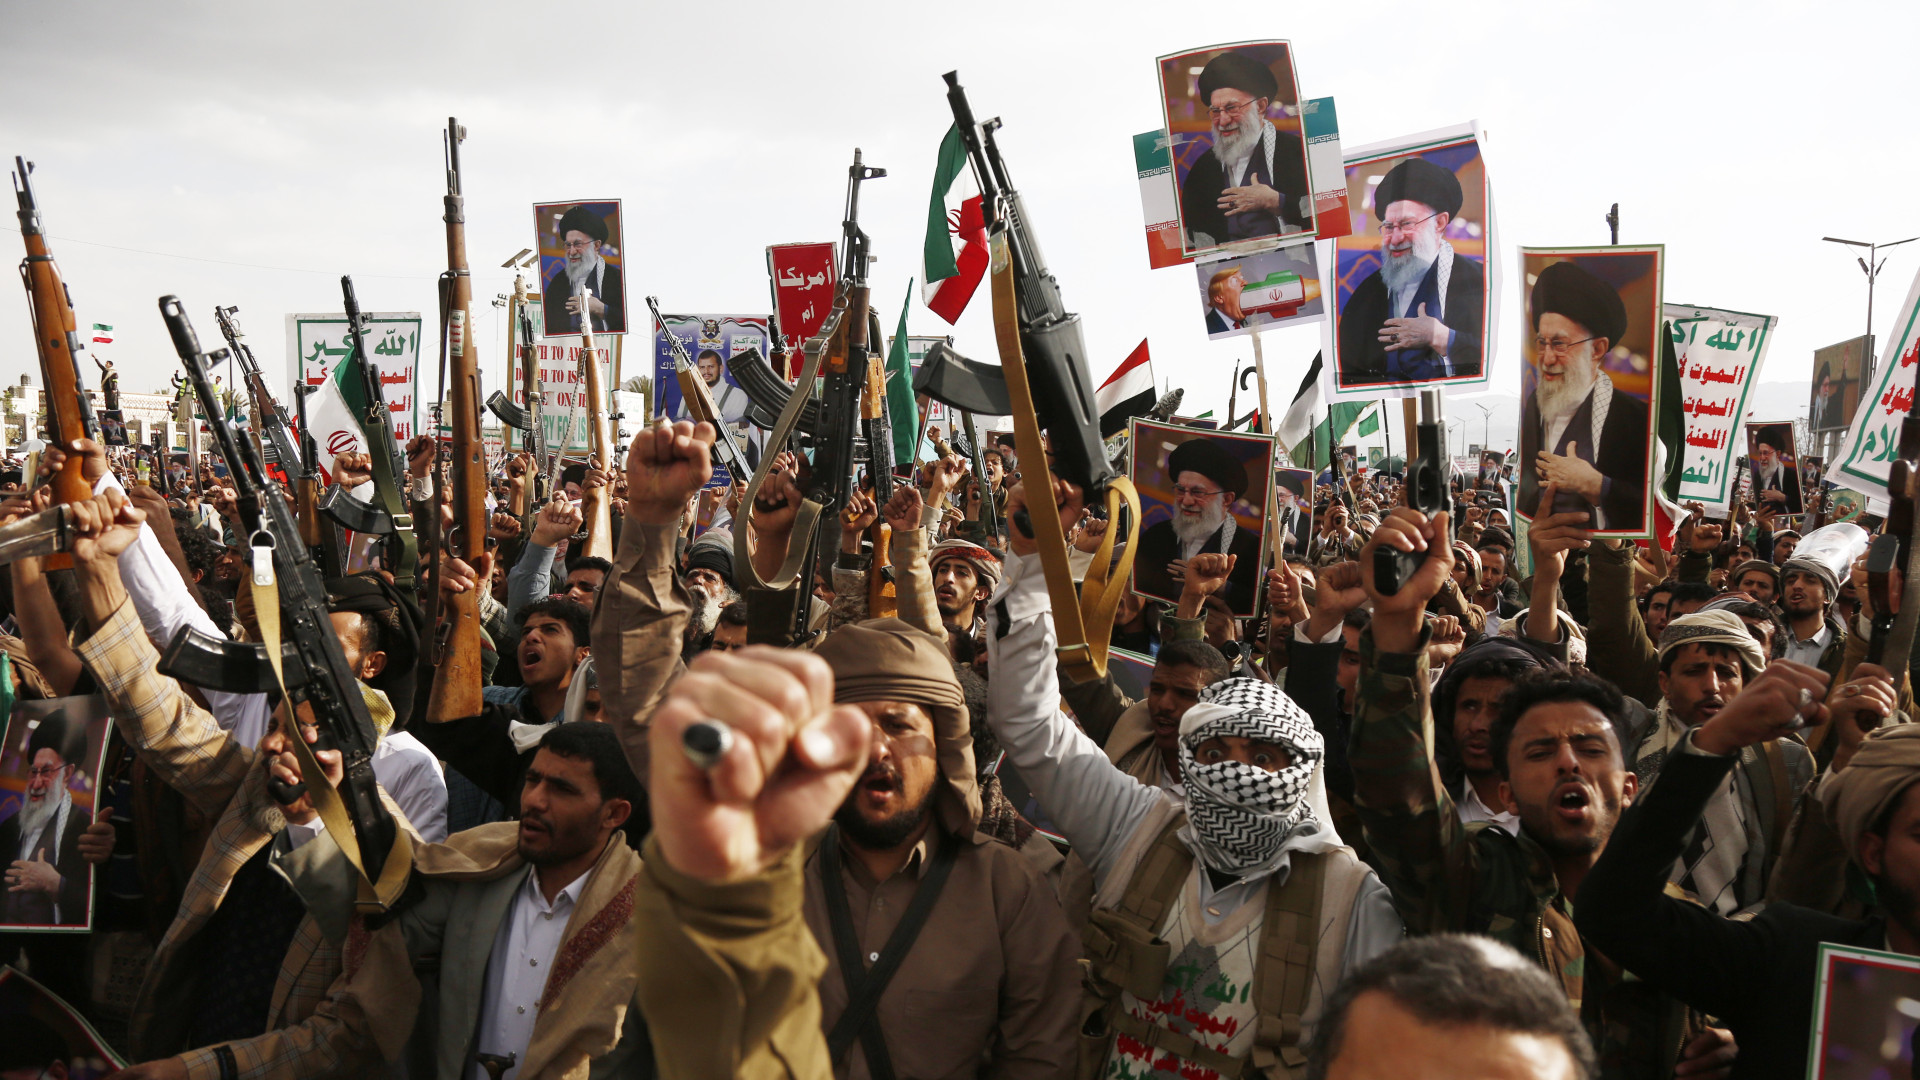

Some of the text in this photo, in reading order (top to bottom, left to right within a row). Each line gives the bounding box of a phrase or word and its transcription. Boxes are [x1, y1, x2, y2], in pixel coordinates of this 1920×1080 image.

[778, 259, 832, 291] أمريكا
[801, 301, 815, 324] أم
[374, 328, 415, 356] الله
[1669, 310, 1758, 352] الله أك
[551, 345, 564, 361] TO
[551, 369, 564, 384] TO
[1690, 362, 1745, 386] الموت
[557, 392, 571, 407] ON
[1683, 395, 1735, 419] الموت
[1686, 424, 1727, 450] اللعنة
[1681, 455, 1720, 486] النص
[1203, 972, 1251, 1004] الله
[1185, 1008, 1238, 1038] الموت
